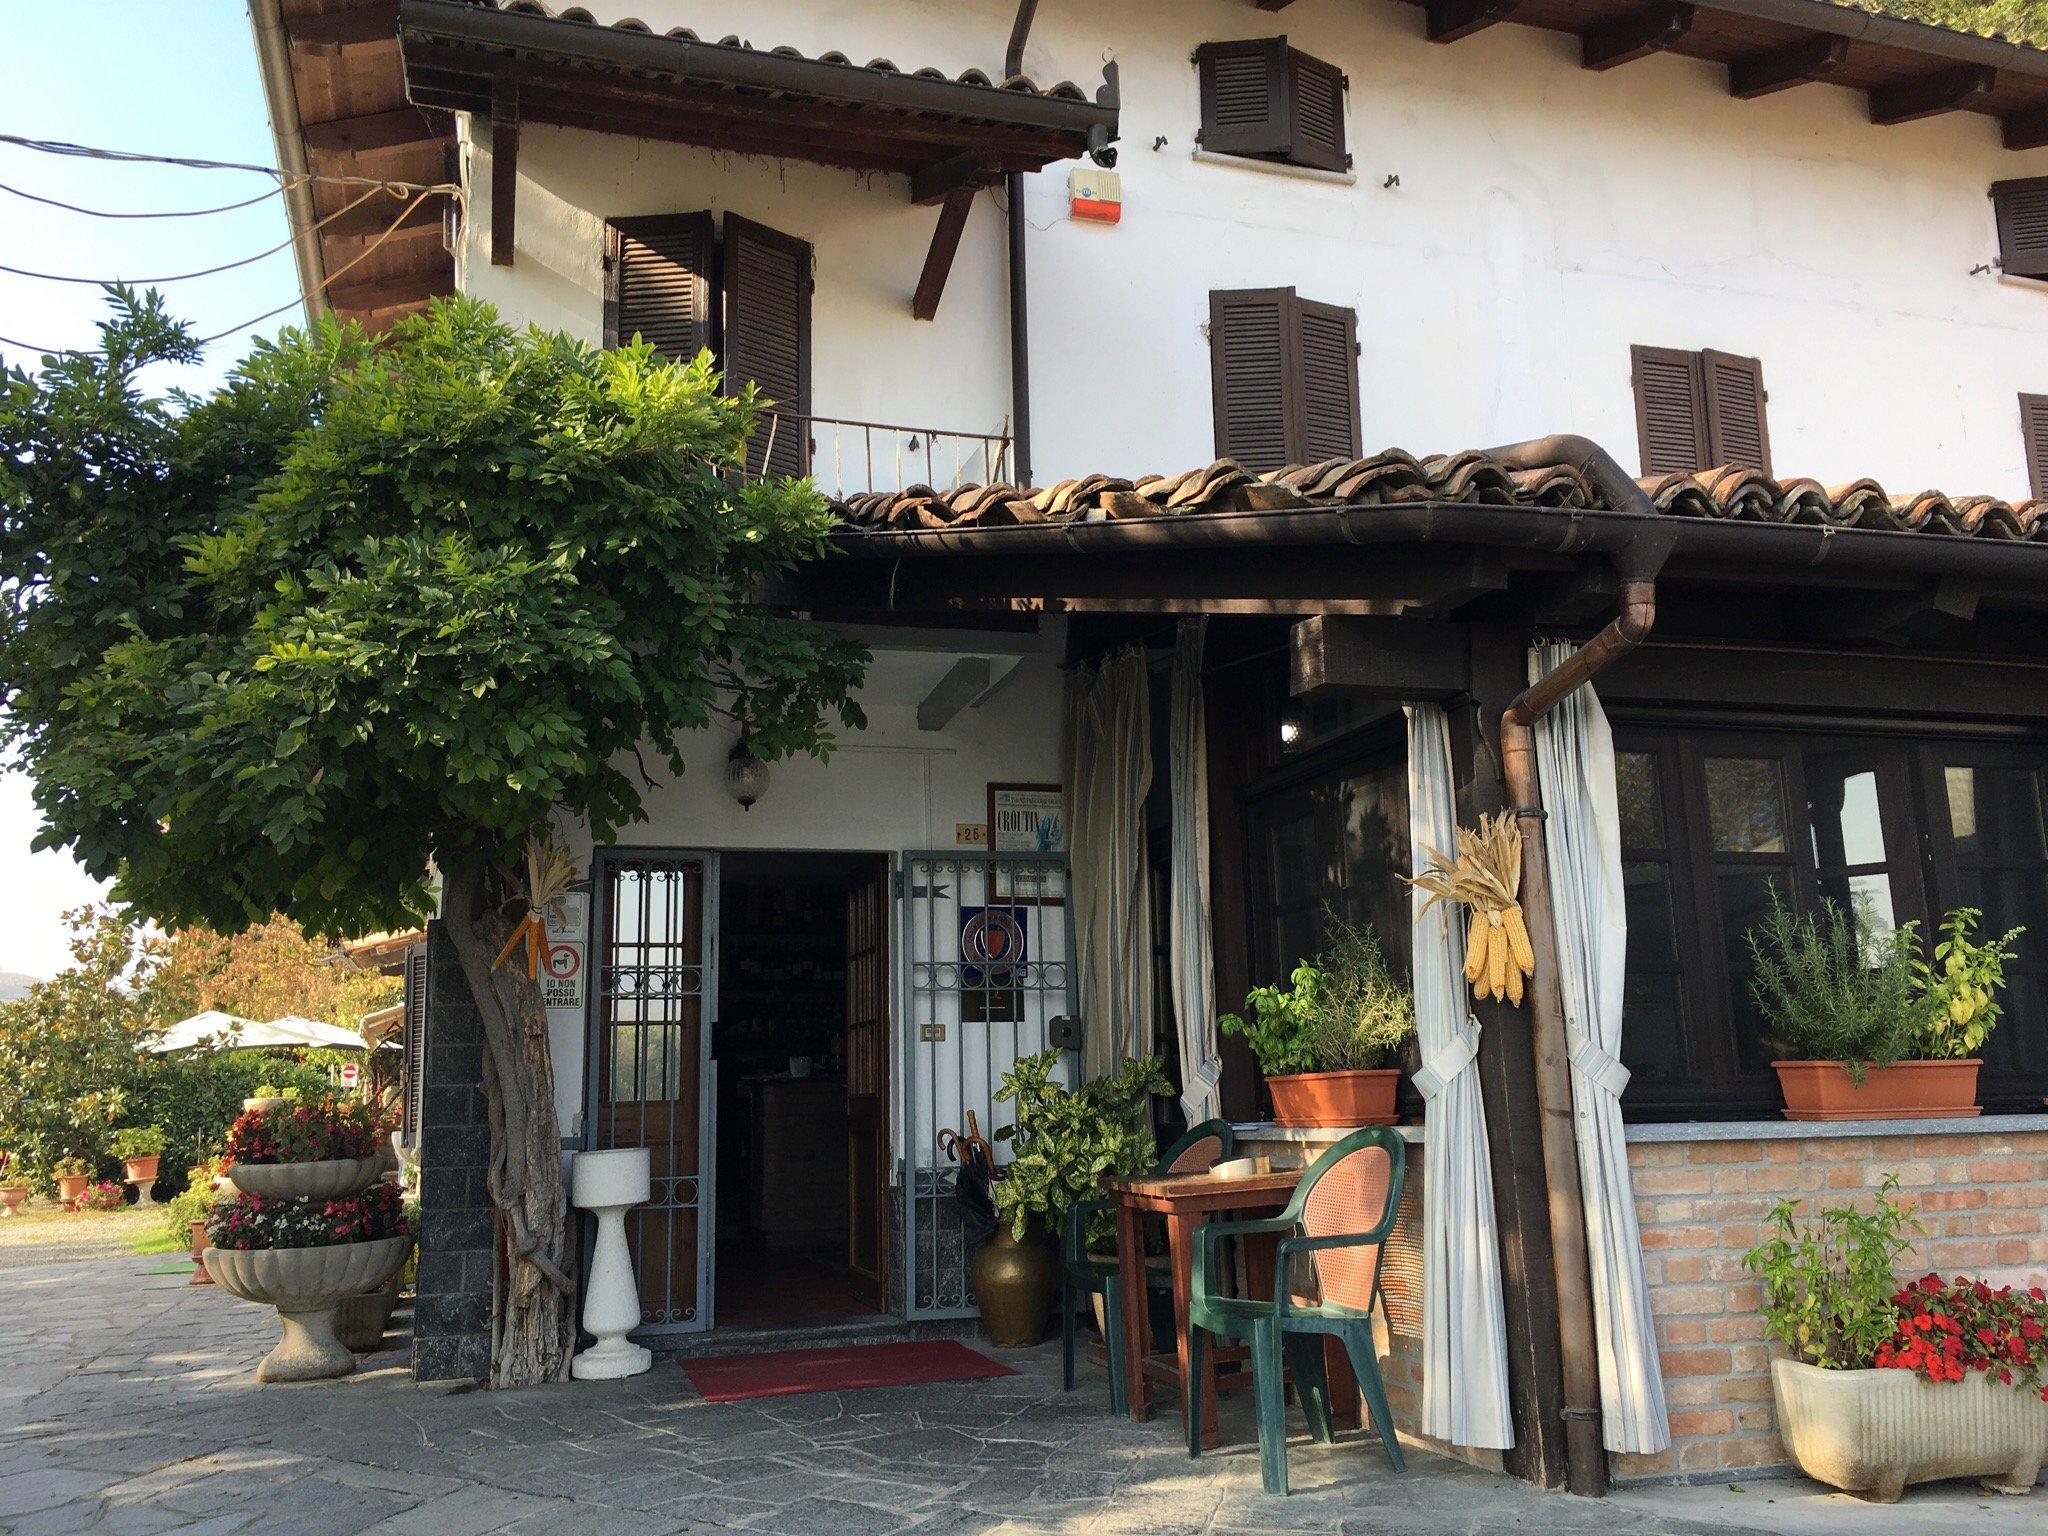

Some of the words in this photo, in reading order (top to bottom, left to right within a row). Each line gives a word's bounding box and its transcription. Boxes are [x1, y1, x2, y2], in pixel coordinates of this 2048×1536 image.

[964, 828, 980, 840] 25
[546, 979, 556, 988] IO
[558, 979, 576, 988] NON
[546, 988, 575, 997] POSSO
